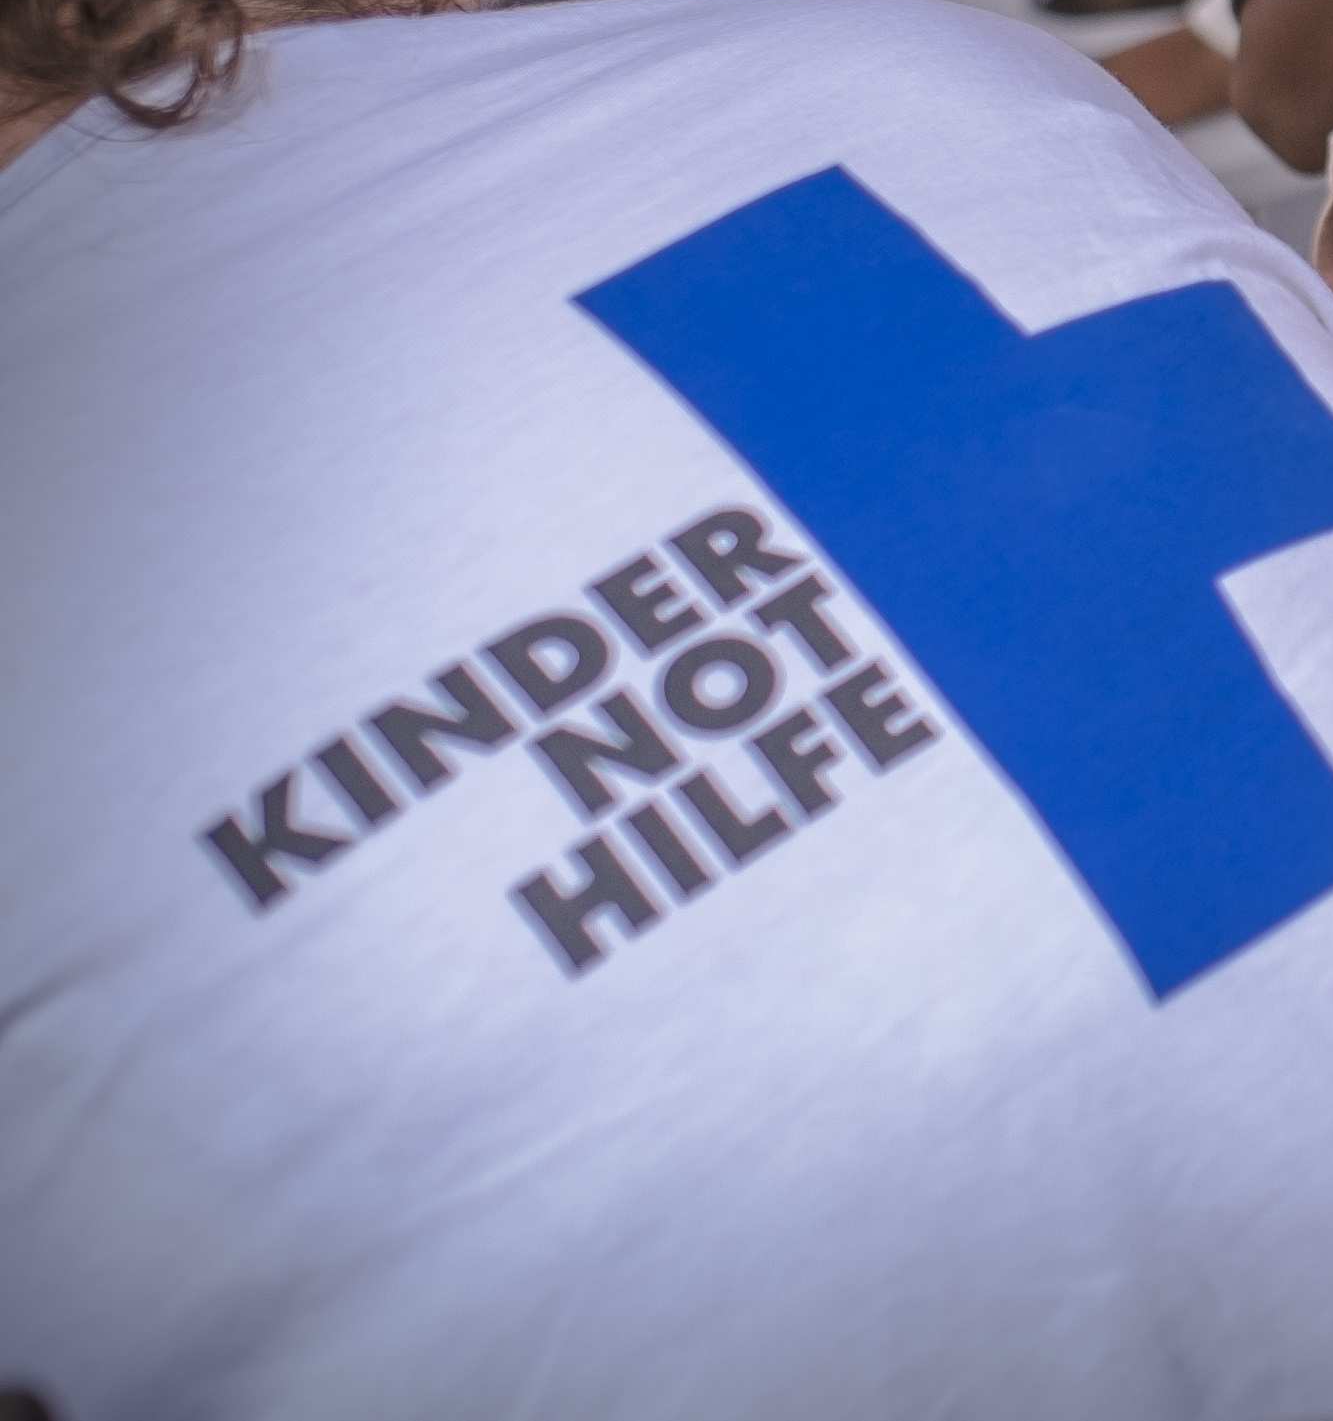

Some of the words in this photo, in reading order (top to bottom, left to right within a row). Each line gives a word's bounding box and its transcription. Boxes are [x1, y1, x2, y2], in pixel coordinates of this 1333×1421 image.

[205, 508, 801, 908] KINDER
[517, 662, 937, 974] HILFE
[533, 574, 853, 819] NOT
